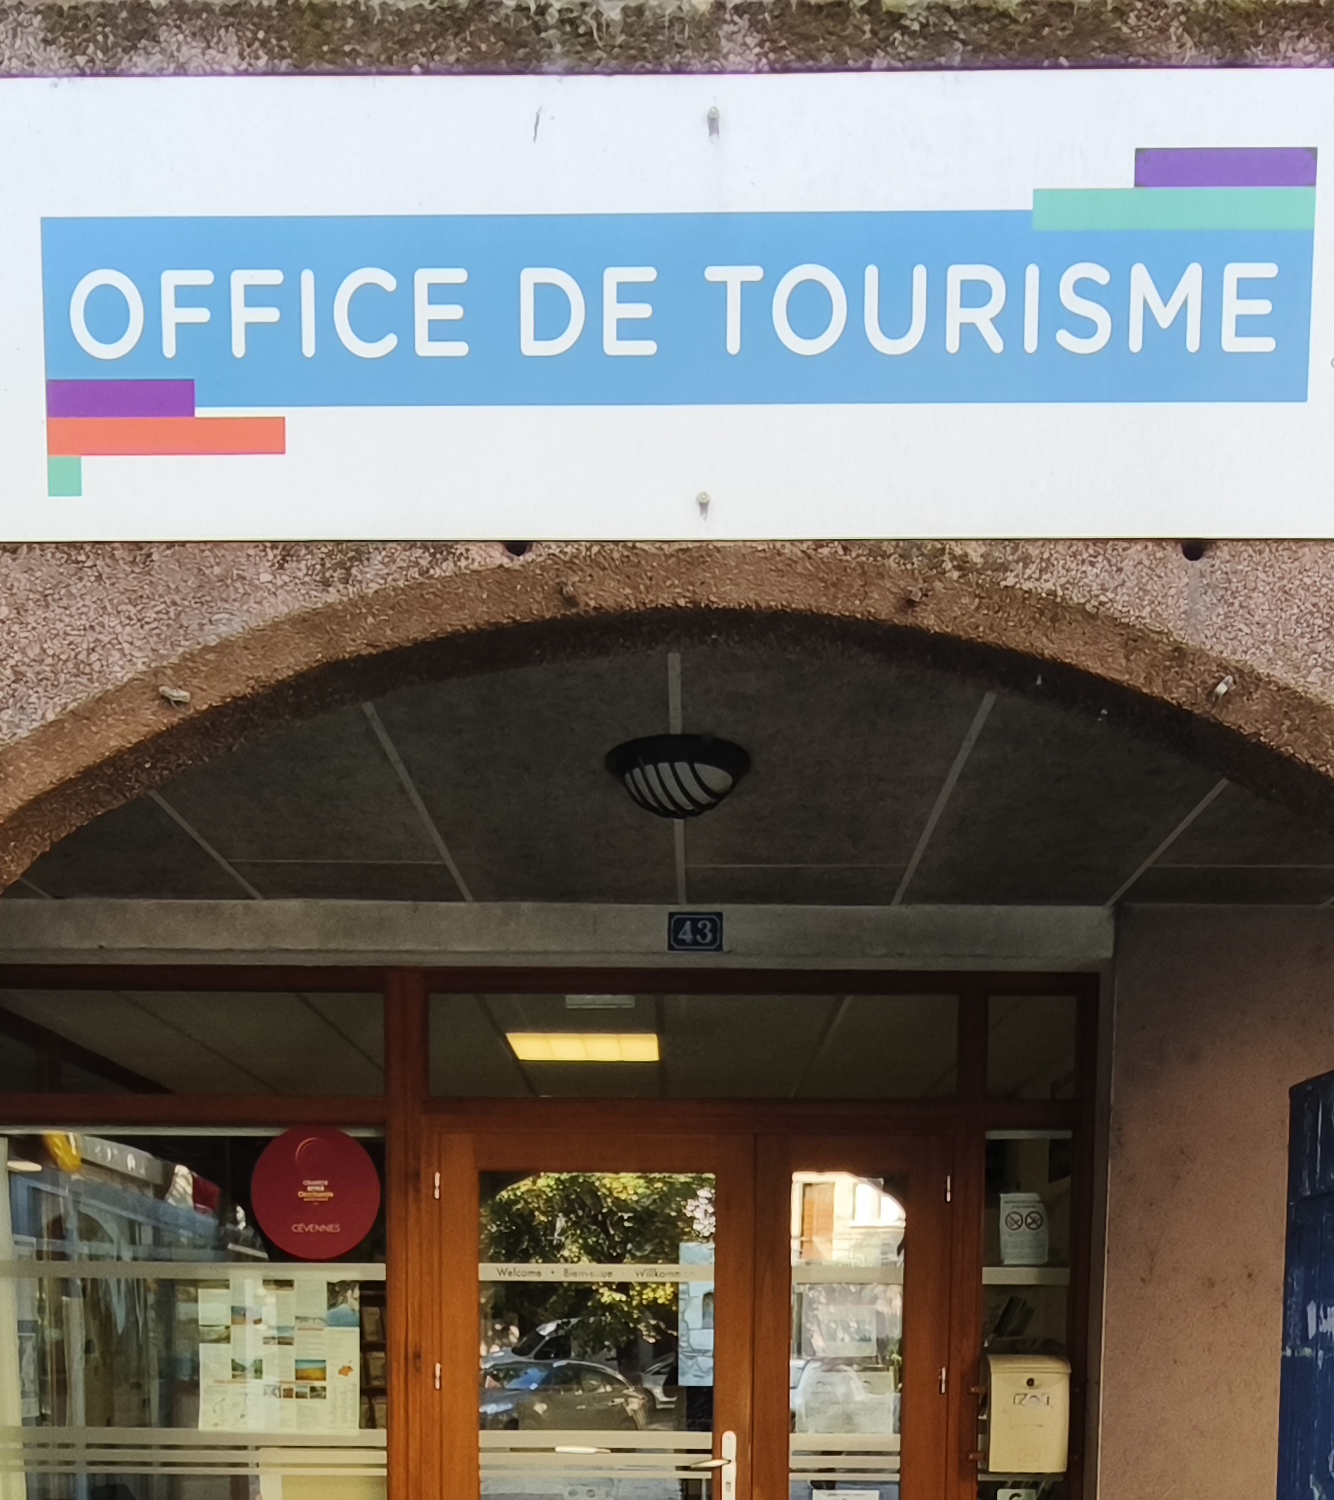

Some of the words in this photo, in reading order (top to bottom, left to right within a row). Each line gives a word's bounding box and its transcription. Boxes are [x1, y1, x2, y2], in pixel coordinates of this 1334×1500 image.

[69, 267, 470, 360] OFFICE
[520, 266, 658, 357] DE
[704, 262, 1279, 356] TOURISME
[676, 919, 714, 945] 43
[495, 1267, 543, 1279] Welcome
[634, 1267, 696, 1279] Willkomm
